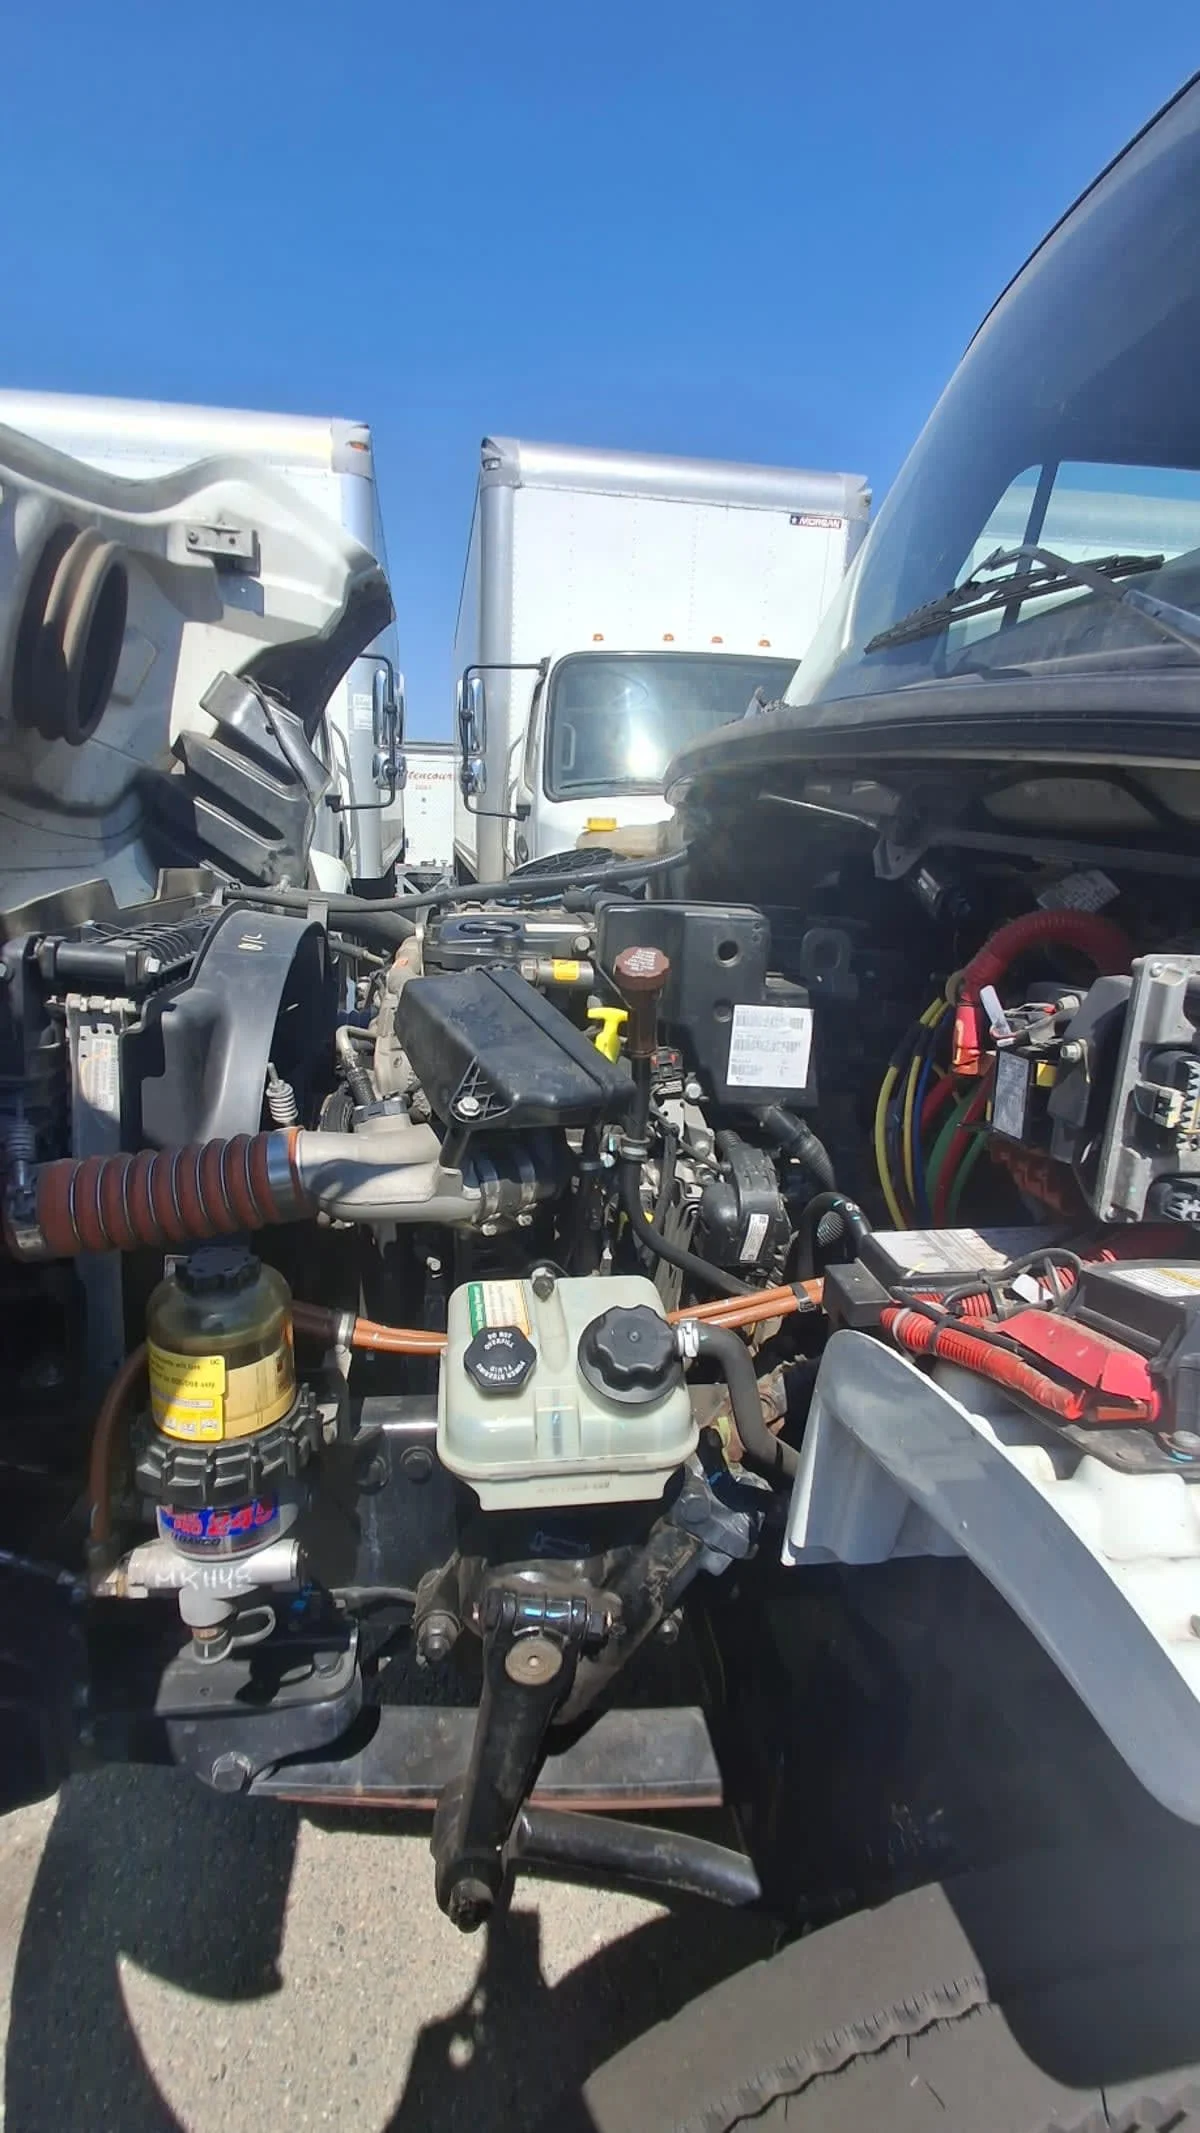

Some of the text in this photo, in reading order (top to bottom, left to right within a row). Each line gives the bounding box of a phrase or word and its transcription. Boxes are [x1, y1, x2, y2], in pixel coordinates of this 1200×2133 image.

[799, 515, 842, 529] MORGAN
[487, 1331, 513, 1341] DO NOT
[484, 1338, 515, 1351] OVERFILL
